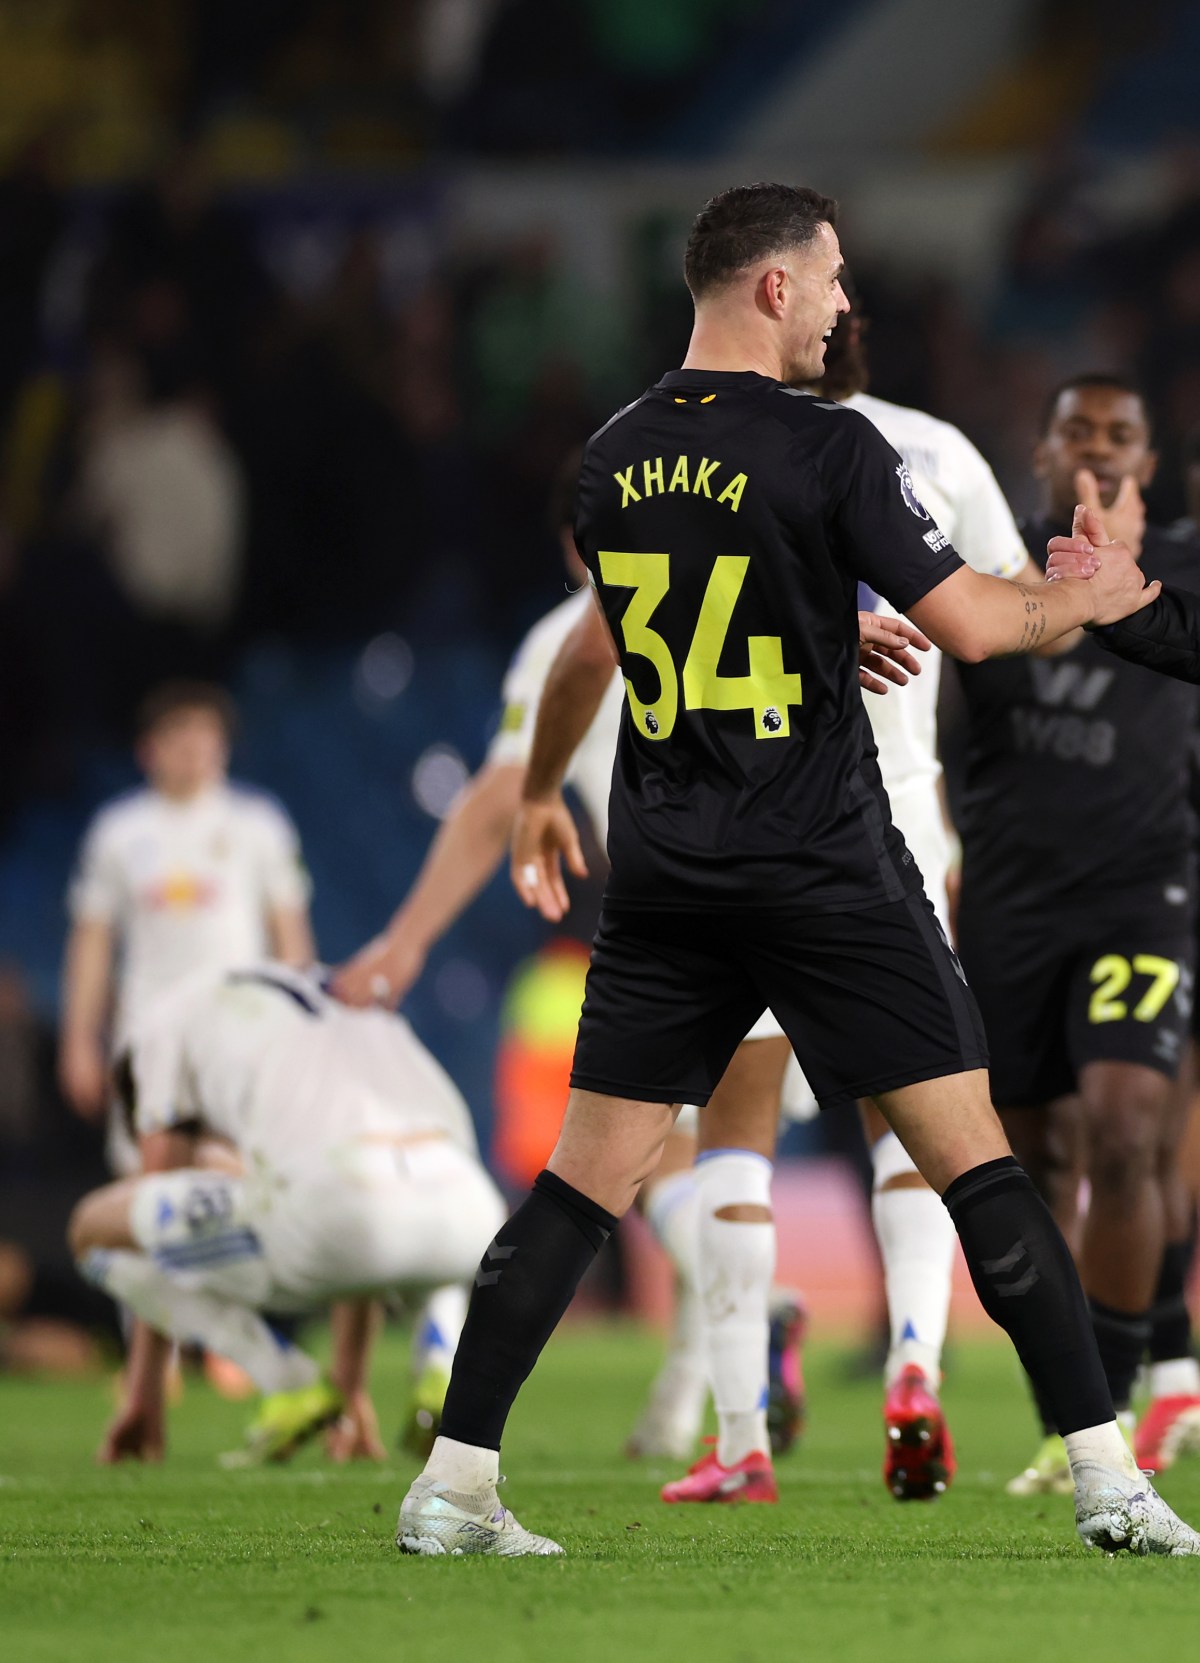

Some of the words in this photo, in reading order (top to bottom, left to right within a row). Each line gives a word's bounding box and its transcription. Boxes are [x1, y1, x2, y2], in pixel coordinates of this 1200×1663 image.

[614, 455, 749, 513] XHAKA
[597, 551, 803, 741] 34
[1088, 953, 1180, 1024] 27
